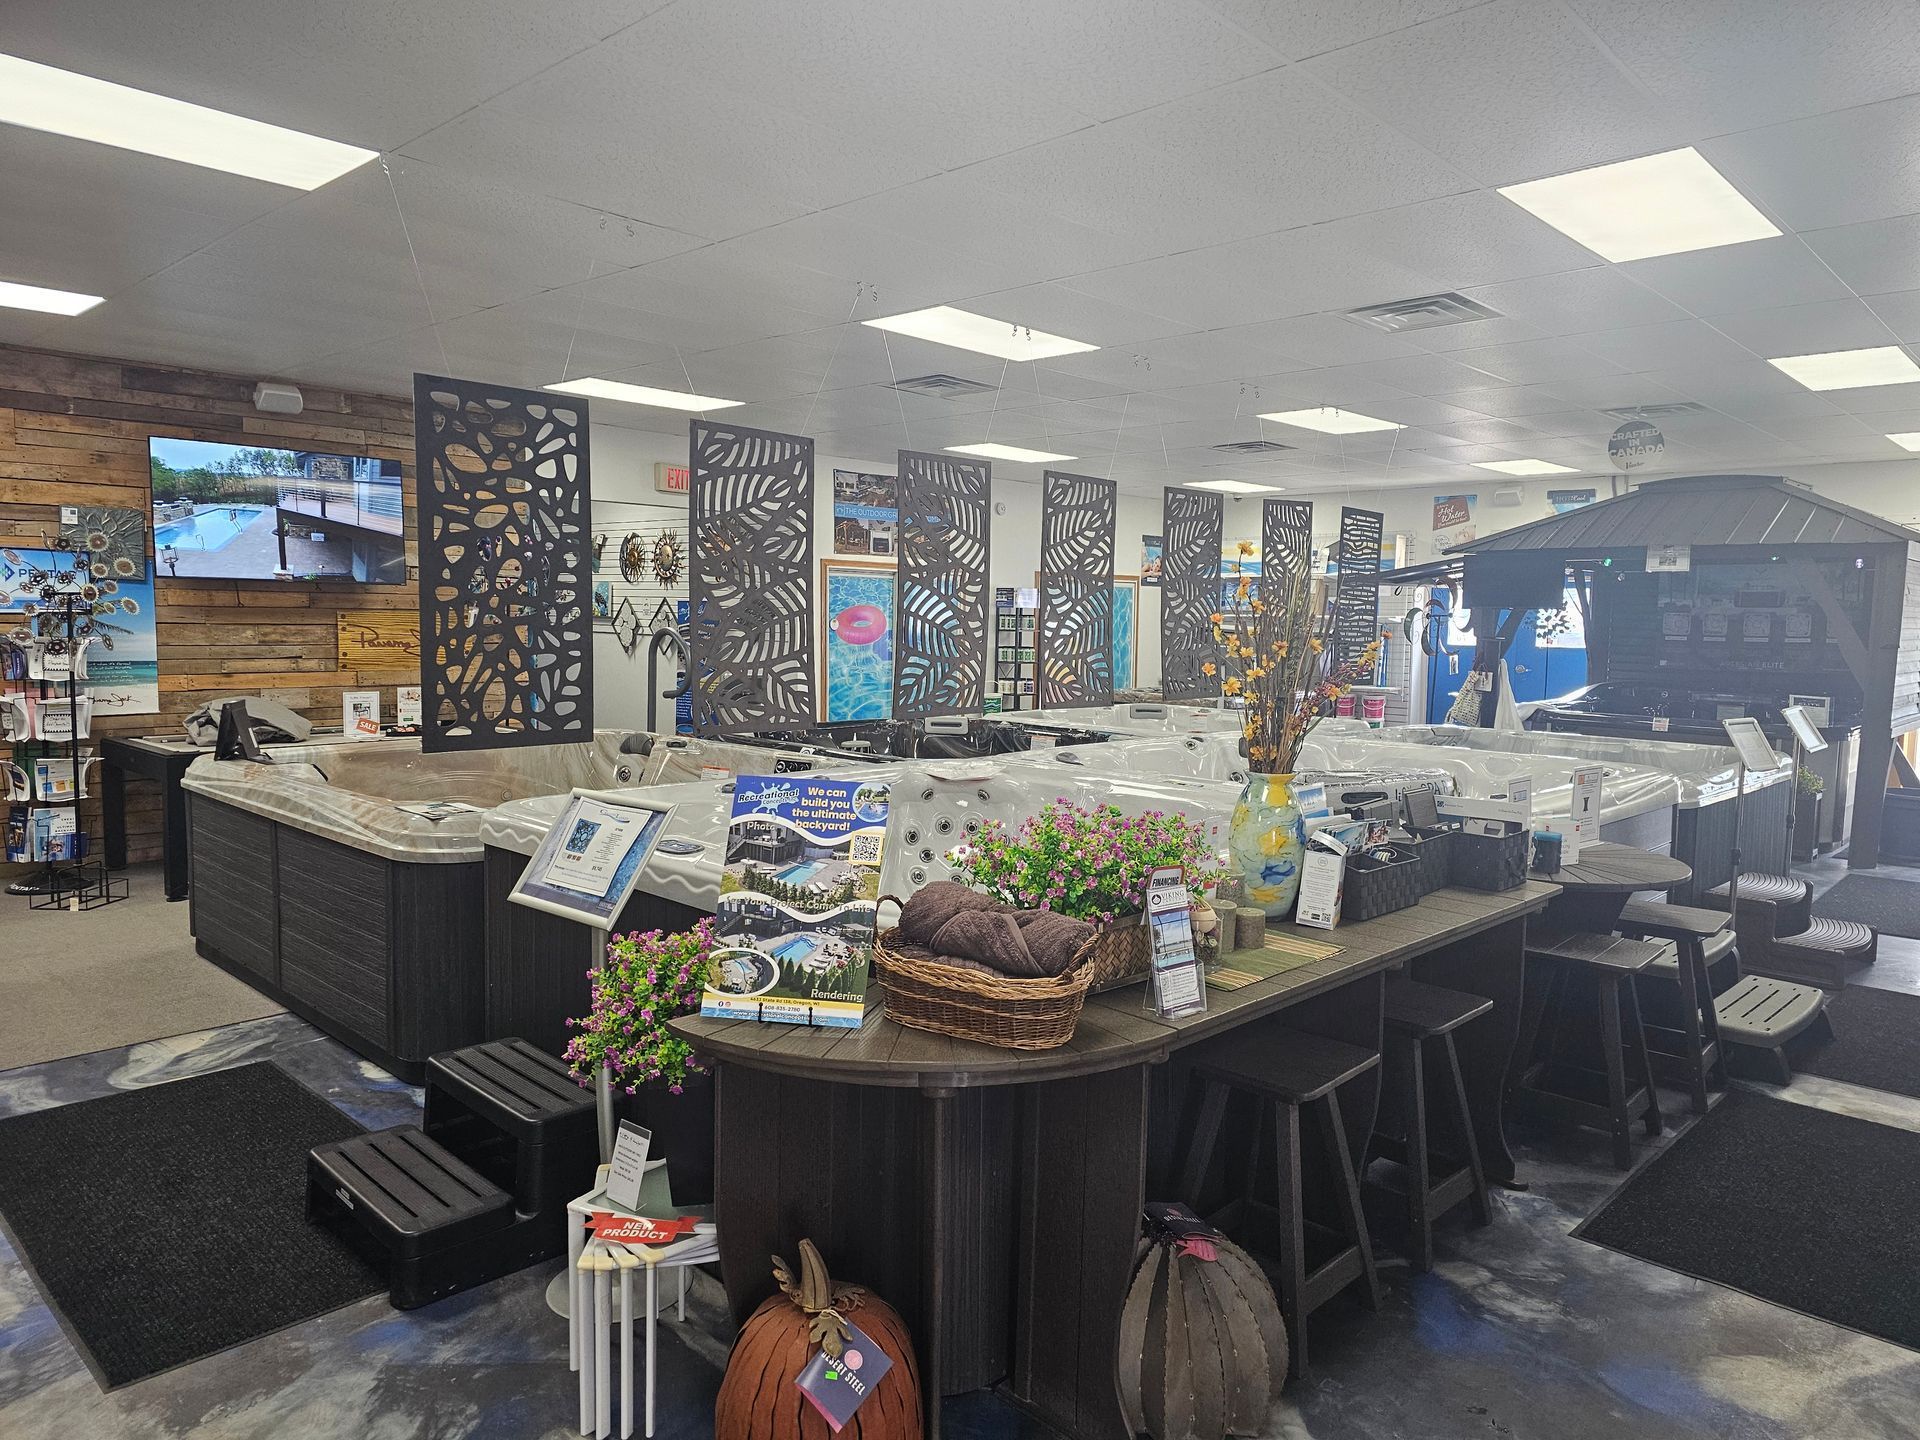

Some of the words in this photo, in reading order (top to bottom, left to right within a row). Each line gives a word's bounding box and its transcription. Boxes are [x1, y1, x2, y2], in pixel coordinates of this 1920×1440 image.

[1610, 428, 1660, 441] CRAFTED
[1628, 438, 1640, 447] IN
[1609, 443, 1665, 458] CANADA
[667, 467, 689, 490] EXIT
[846, 507, 857, 515] THE
[858, 508, 887, 518] OUTDOOR
[359, 721, 377, 731] SALE
[738, 788, 800, 803] Recreational
[808, 787, 825, 796] We
[826, 788, 846, 798] can
[801, 797, 829, 808] build
[830, 800, 850, 811] you
[792, 808, 810, 817] the
[811, 808, 857, 820] ultimate
[746, 821, 776, 831] Photo
[796, 819, 850, 832] backyard!
[1152, 876, 1180, 888] FINANCING
[1161, 889, 1185, 899] VIKING
[770, 898, 805, 910] Project
[806, 900, 835, 911] Come
[837, 902, 849, 911] To
[852, 903, 871, 913] Life
[810, 988, 864, 1003] Rendering
[623, 1221, 656, 1230] NEW
[602, 1228, 669, 1240] PRODUCT
[844, 1371, 866, 1396] STEEL
